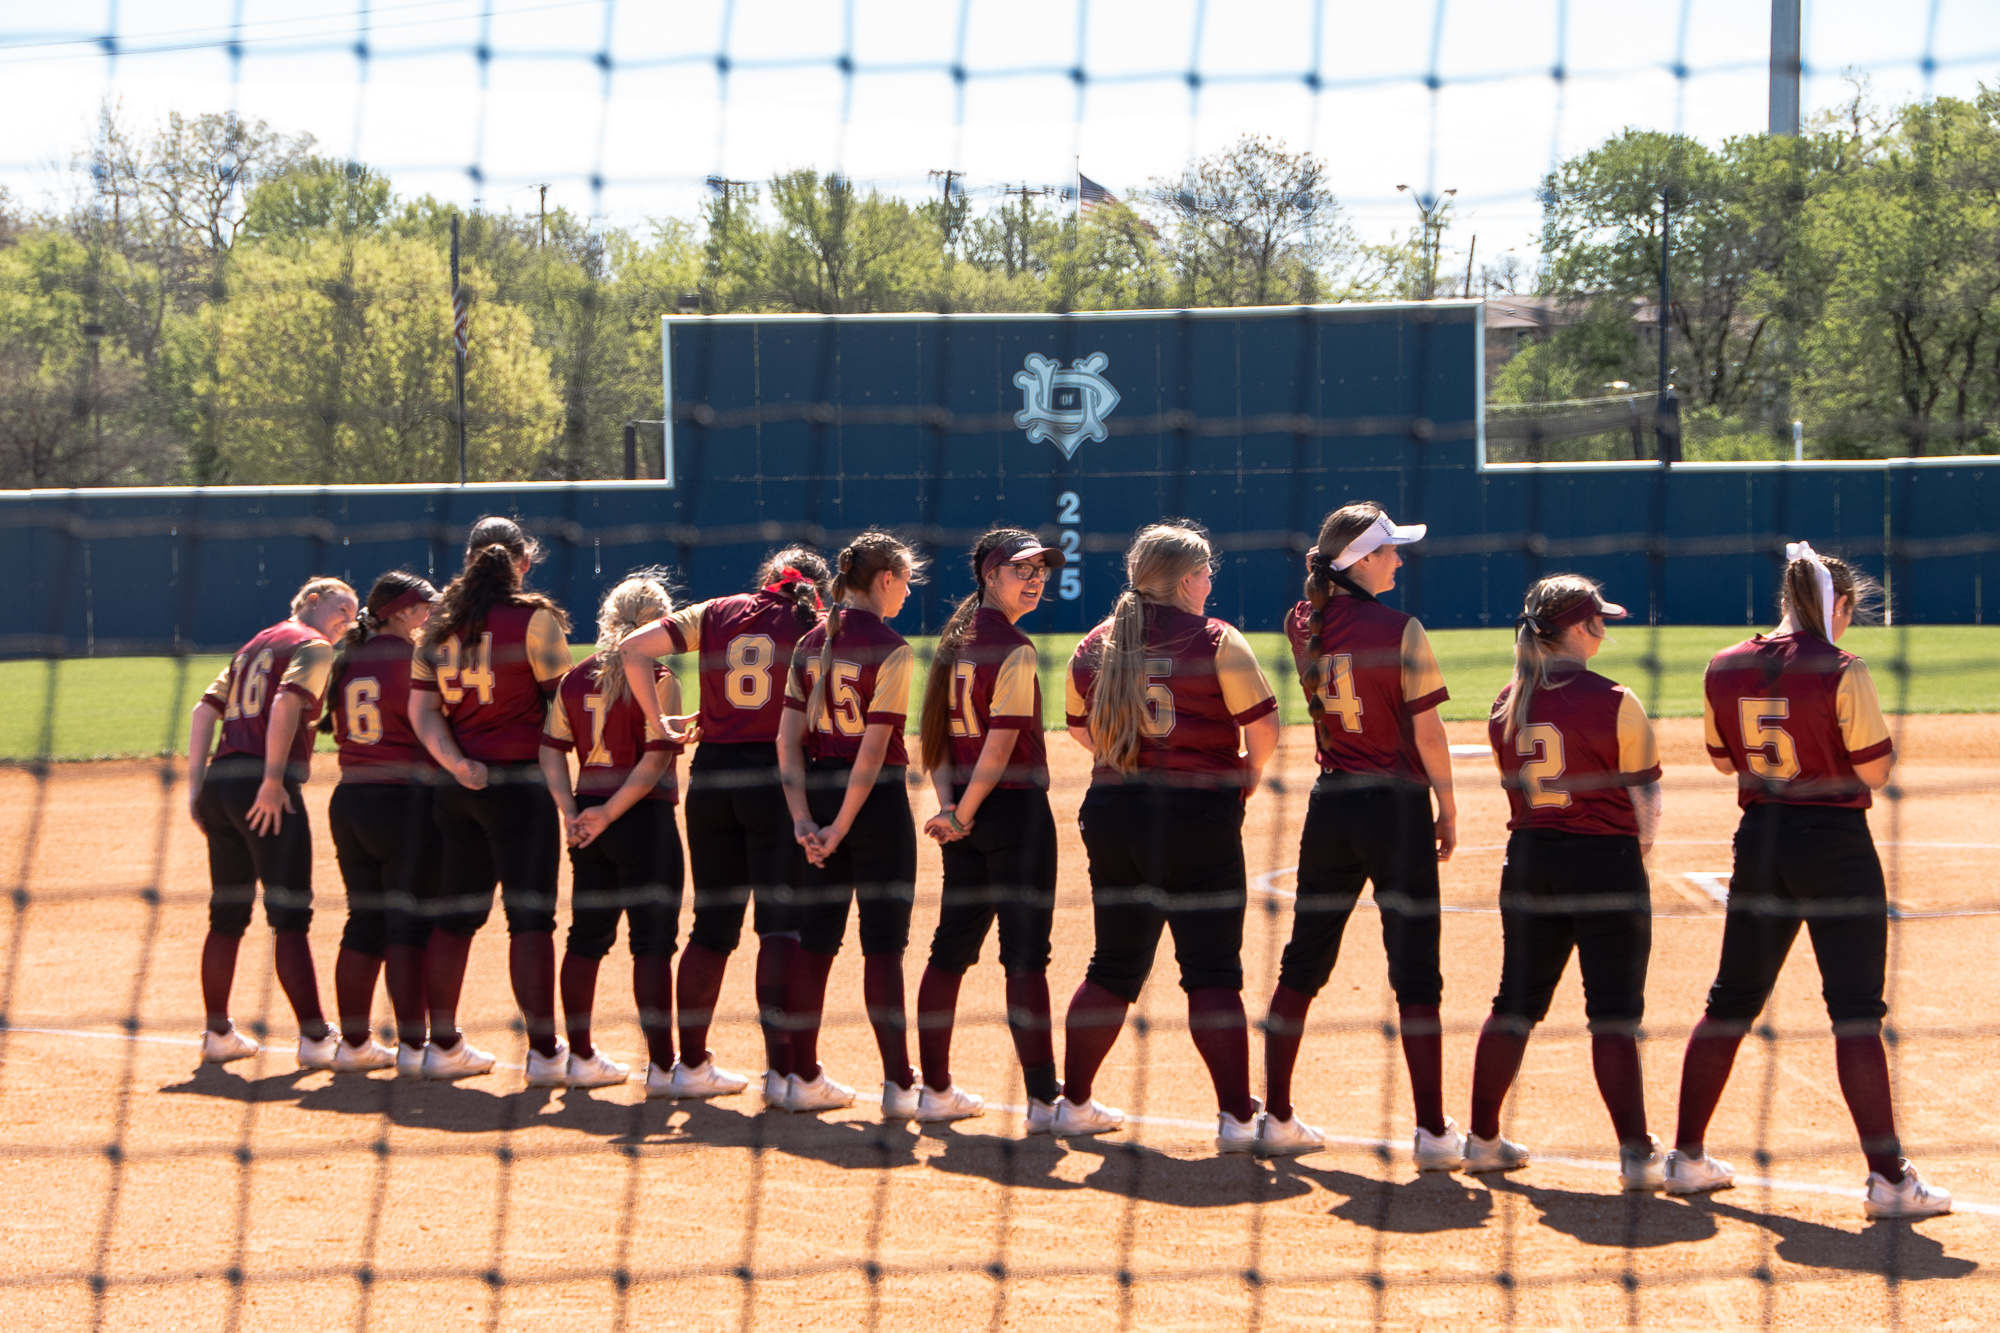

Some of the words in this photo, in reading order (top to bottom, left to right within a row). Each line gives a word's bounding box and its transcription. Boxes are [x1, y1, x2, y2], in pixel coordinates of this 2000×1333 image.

[1057, 491, 1082, 600] 225
[224, 648, 274, 721] 16
[436, 631, 495, 705] 24
[724, 633, 776, 709] 8
[806, 656, 867, 736] 15
[1318, 653, 1364, 733] 4
[344, 676, 383, 746] 6
[584, 694, 613, 767] 1
[1738, 697, 1801, 781] 5
[1515, 722, 1573, 809] 2
